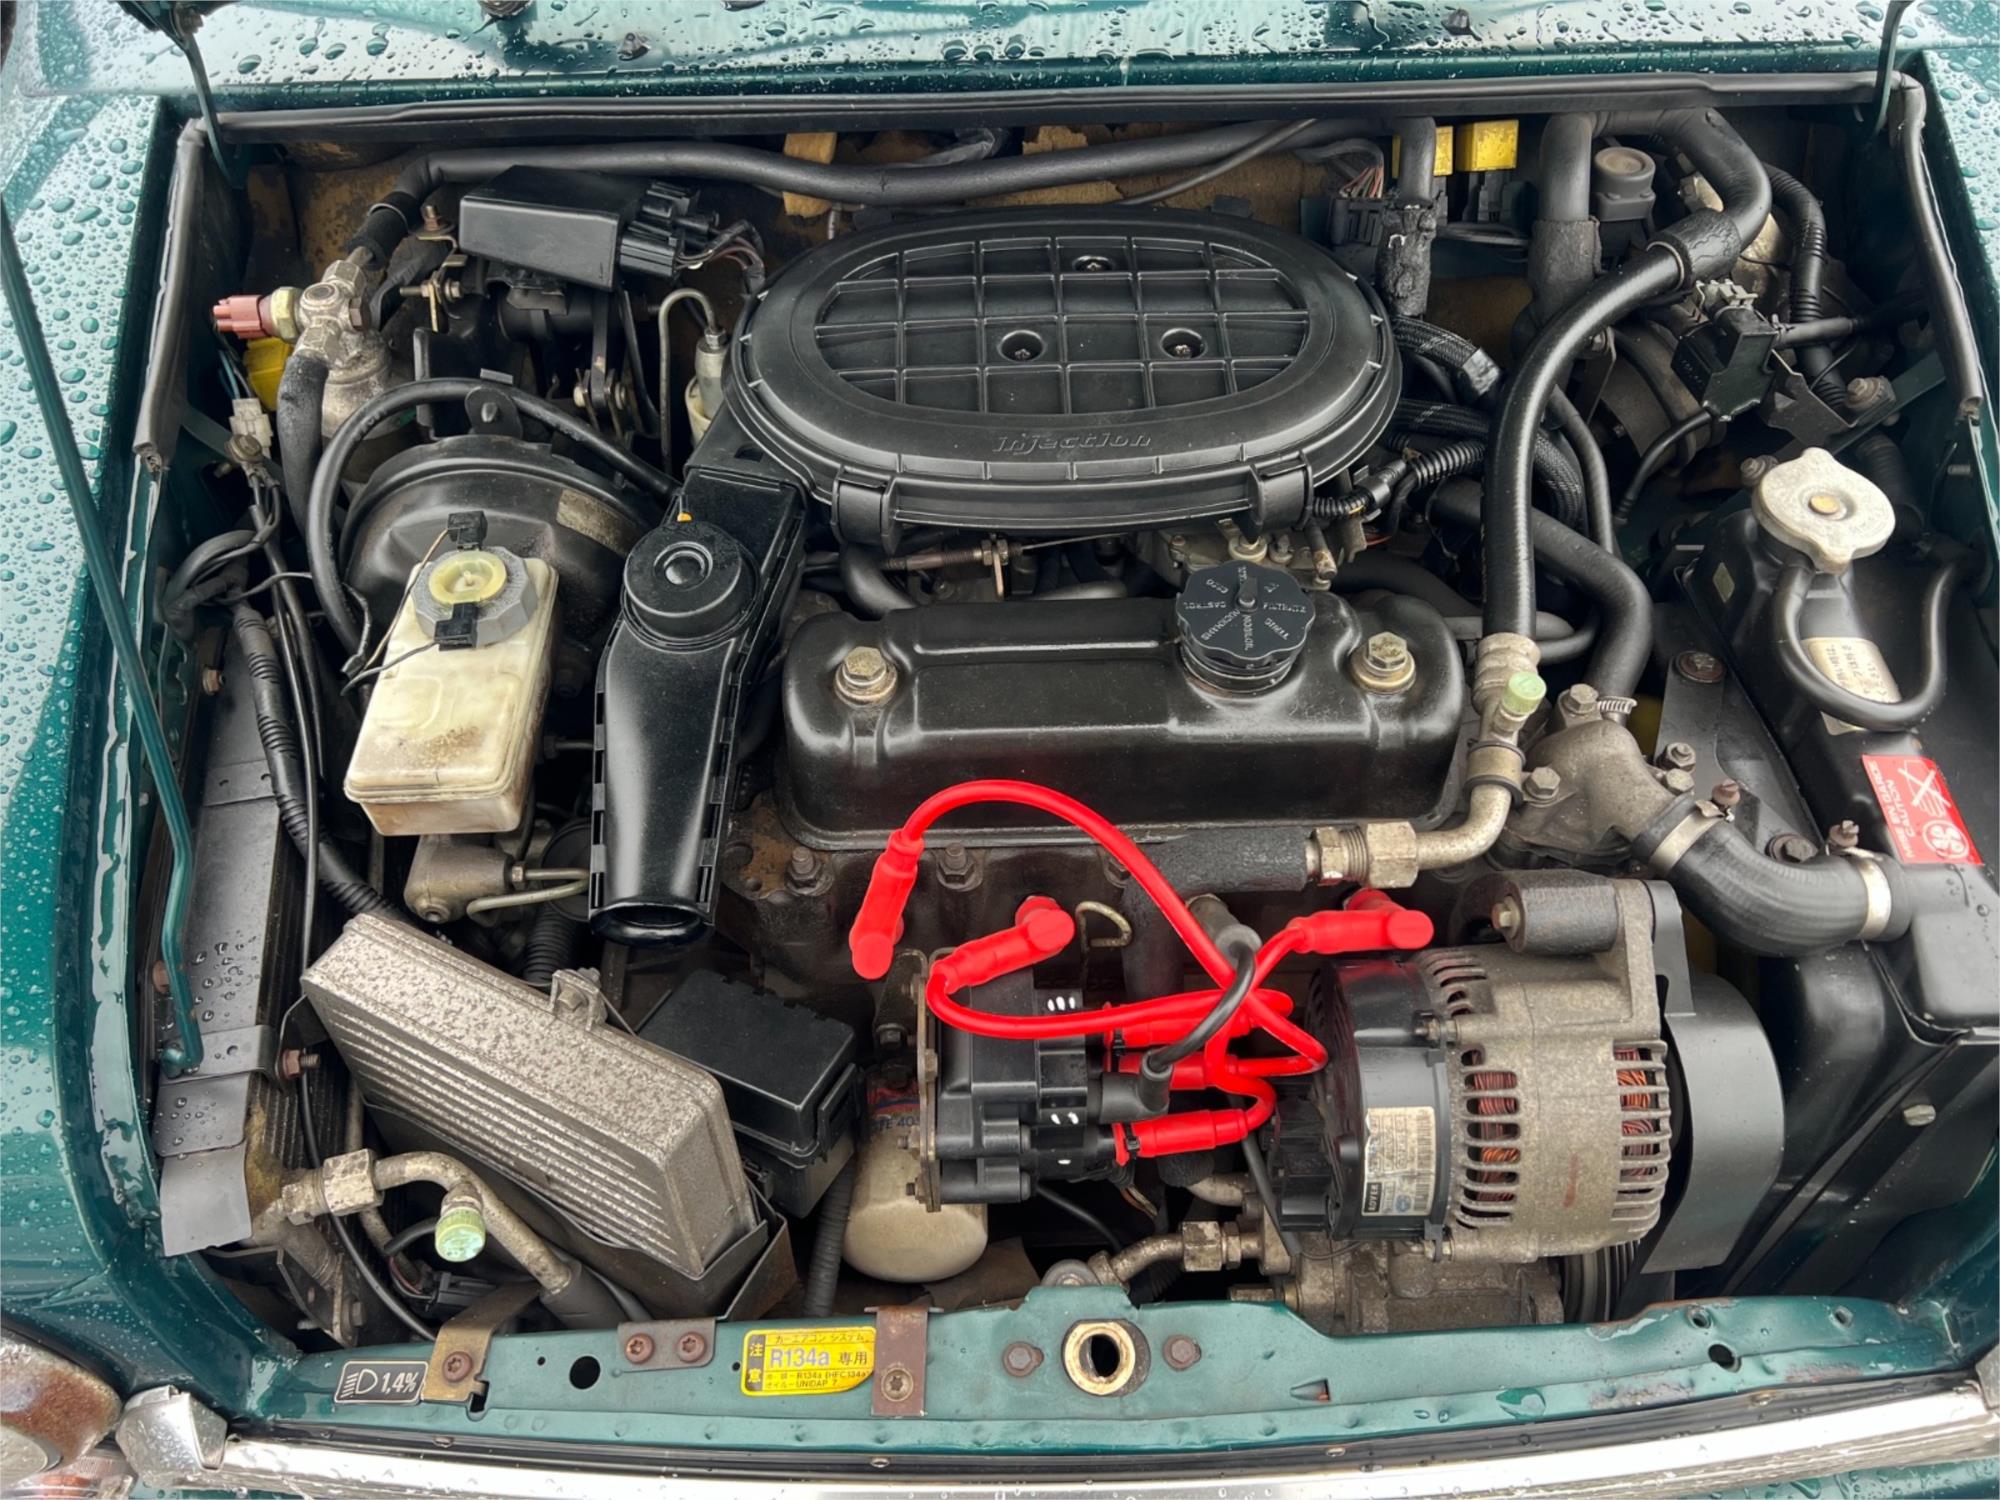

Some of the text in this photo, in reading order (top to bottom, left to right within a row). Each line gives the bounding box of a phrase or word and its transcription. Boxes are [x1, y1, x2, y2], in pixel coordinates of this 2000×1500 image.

[1885, 779, 1916, 838] CAUTION
[770, 1347, 867, 1368] R134a 専用
[381, 1371, 420, 1395] 1,4%
